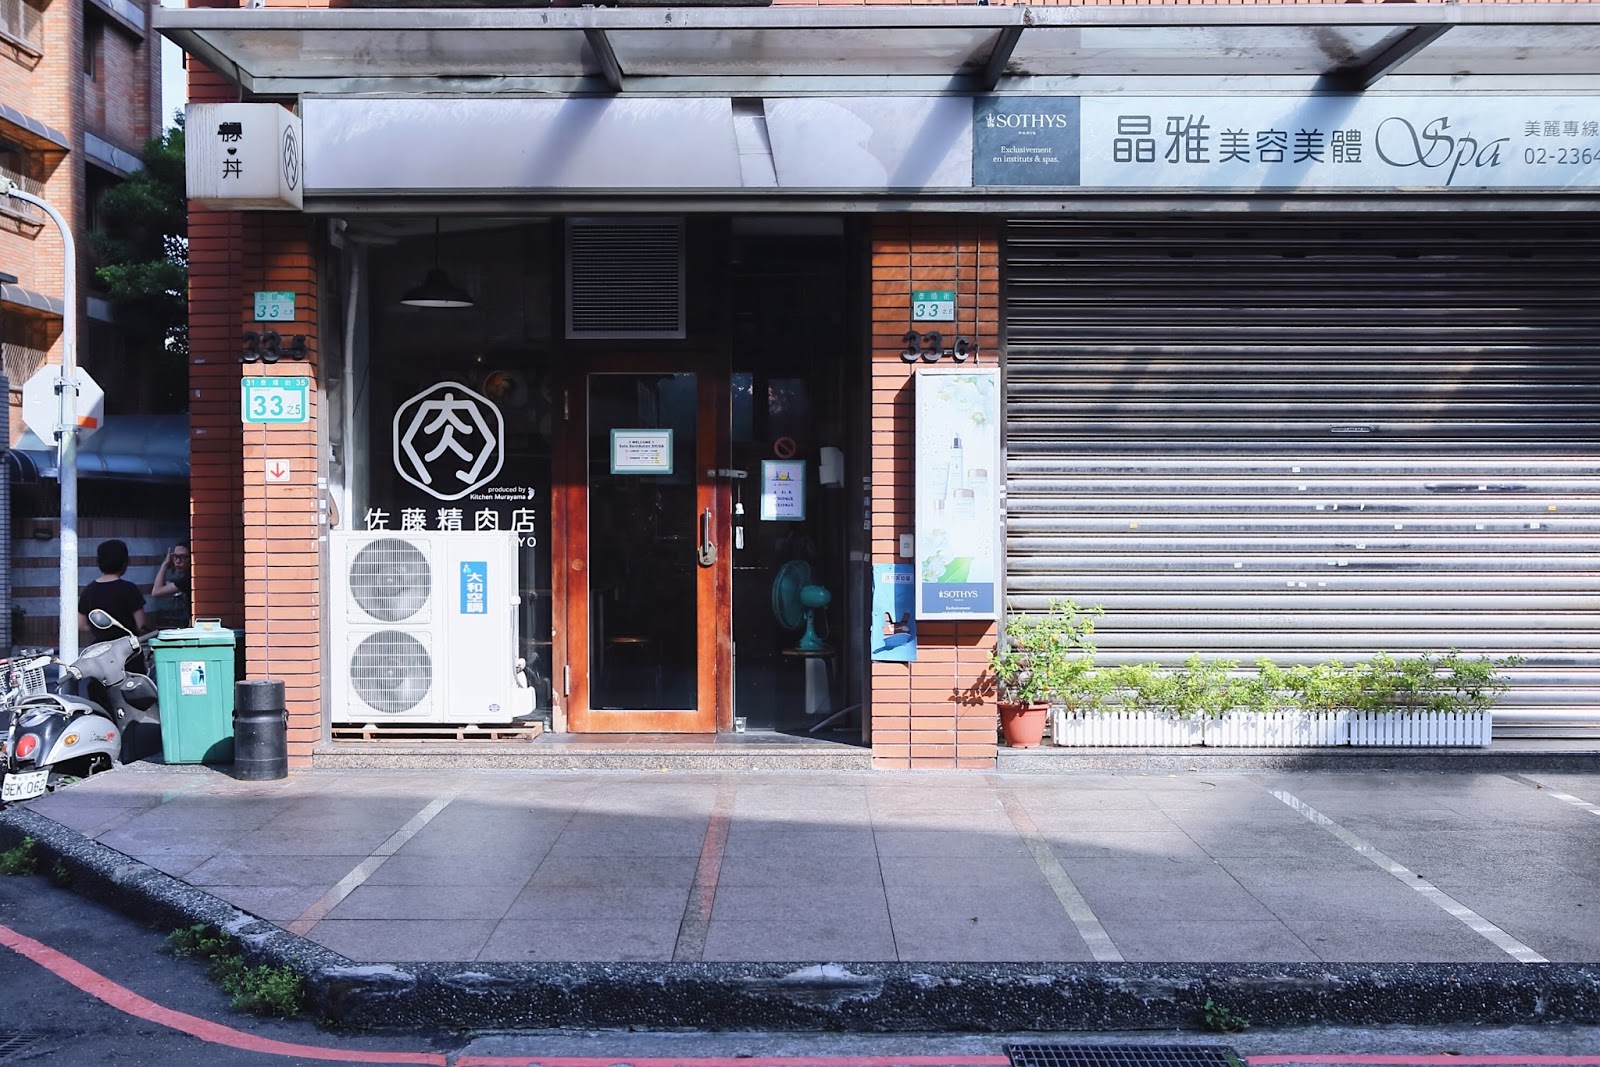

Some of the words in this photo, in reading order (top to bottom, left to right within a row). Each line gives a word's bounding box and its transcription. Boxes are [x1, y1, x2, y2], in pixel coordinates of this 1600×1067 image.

[996, 113, 1067, 128] SOTHYS
[1524, 119, 1600, 138] 美麗專線
[1113, 114, 1363, 164] 晶雅美容美體
[1001, 145, 1051, 153] Exclusivement
[1375, 116, 1510, 186] Spa
[1003, 155, 1033, 163] instituts
[1034, 155, 1041, 163] &
[1042, 156, 1060, 164] spas.
[245, 379, 255, 387] 31
[295, 379, 306, 387] 35
[488, 486, 517, 494] produced
[518, 486, 526, 494] by
[494, 493, 526, 501] Murayama
[364, 507, 536, 532] 佐藤精肉店
[466, 572, 484, 613] 大和空調
[943, 590, 978, 599] SOTHYS
